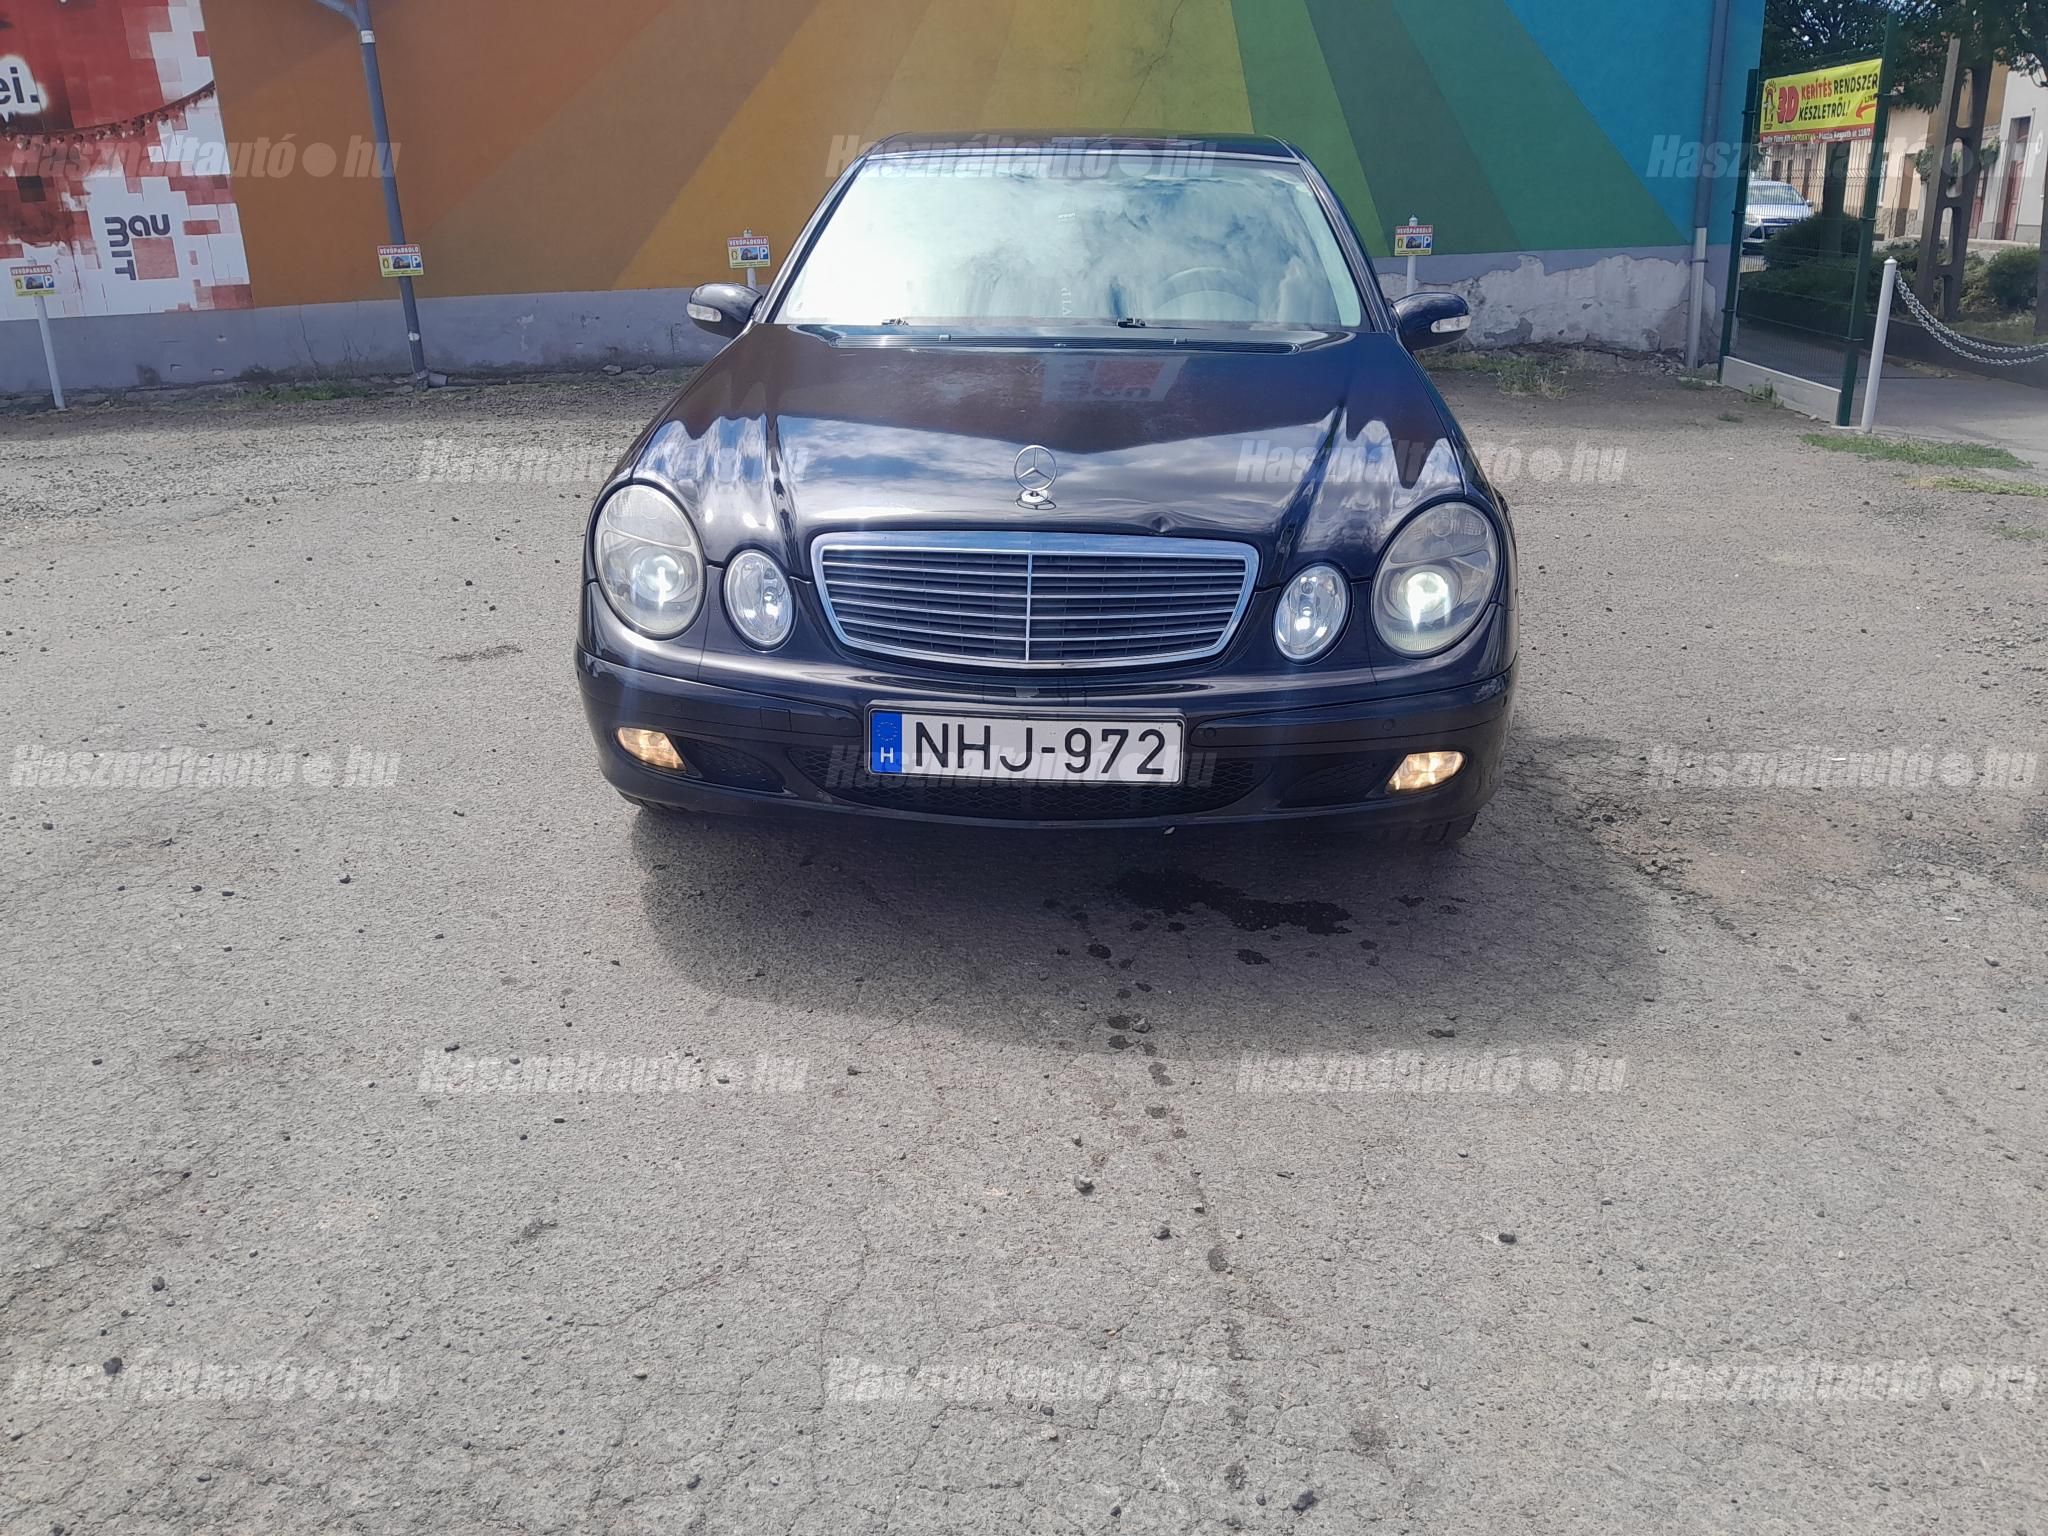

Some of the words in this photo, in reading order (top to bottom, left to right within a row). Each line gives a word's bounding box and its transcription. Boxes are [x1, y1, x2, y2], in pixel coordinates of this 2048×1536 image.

[1777, 84, 1800, 123] 3D
[1800, 77, 1833, 101] KERÍTÉS
[1833, 72, 1878, 92] RENDSZER
[1799, 97, 1850, 121] KÉSZLETRŐL!
[880, 746, 894, 763] H
[915, 720, 1166, 775] NHJ-972
